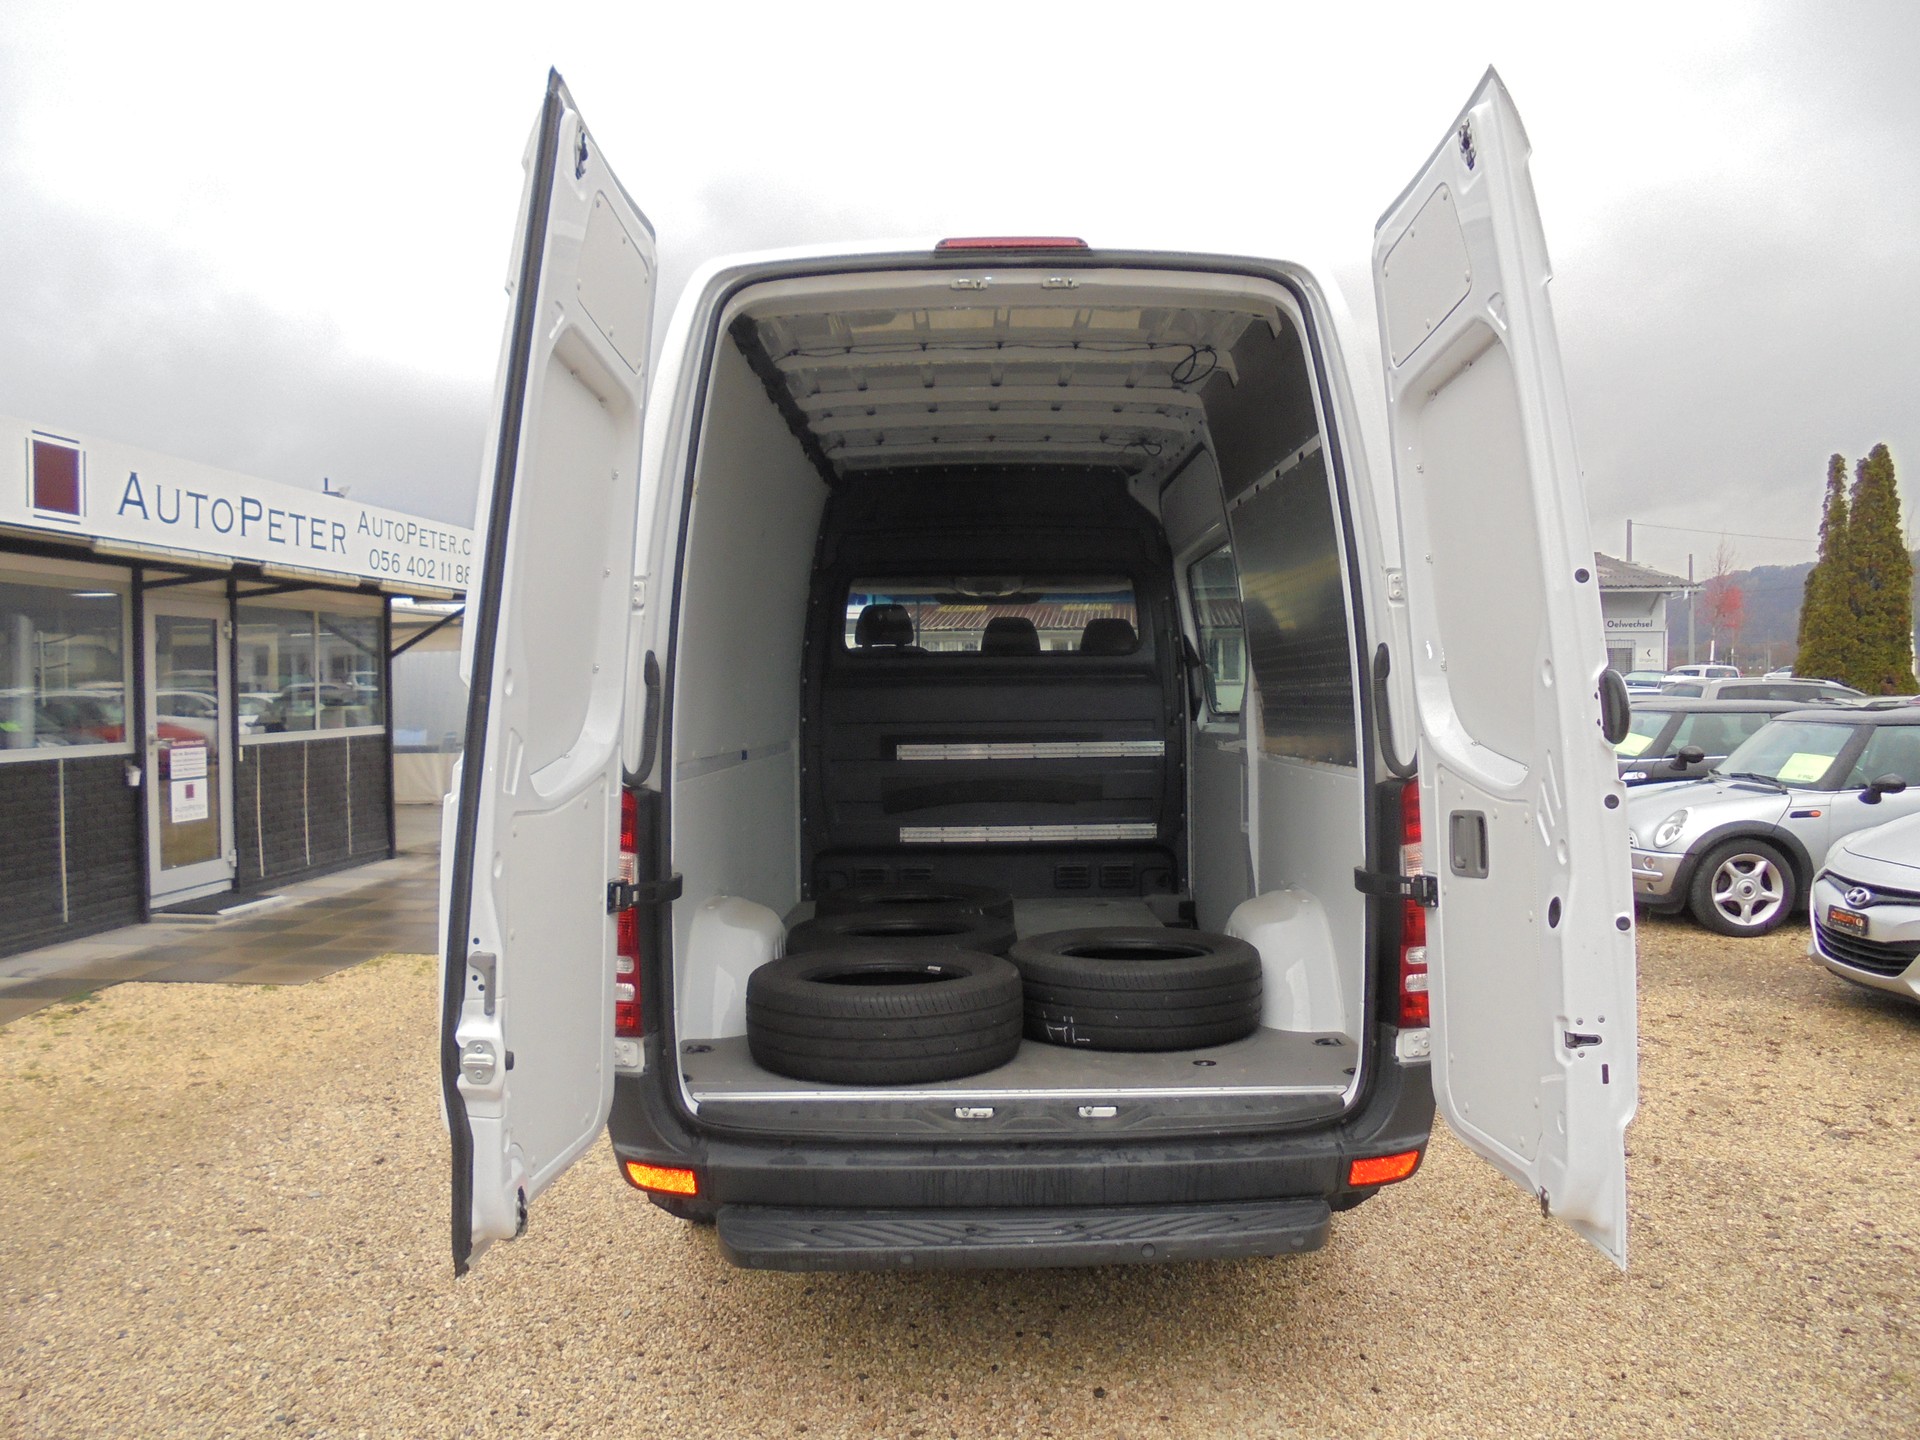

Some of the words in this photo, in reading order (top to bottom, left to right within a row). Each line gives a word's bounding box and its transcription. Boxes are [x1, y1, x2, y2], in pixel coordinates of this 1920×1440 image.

[117, 471, 346, 554] AUTOPETER
[369, 548, 401, 574] 056
[406, 556, 436, 579] 402
[441, 561, 452, 582] 11
[1606, 619, 1653, 628] Oelwechsel
